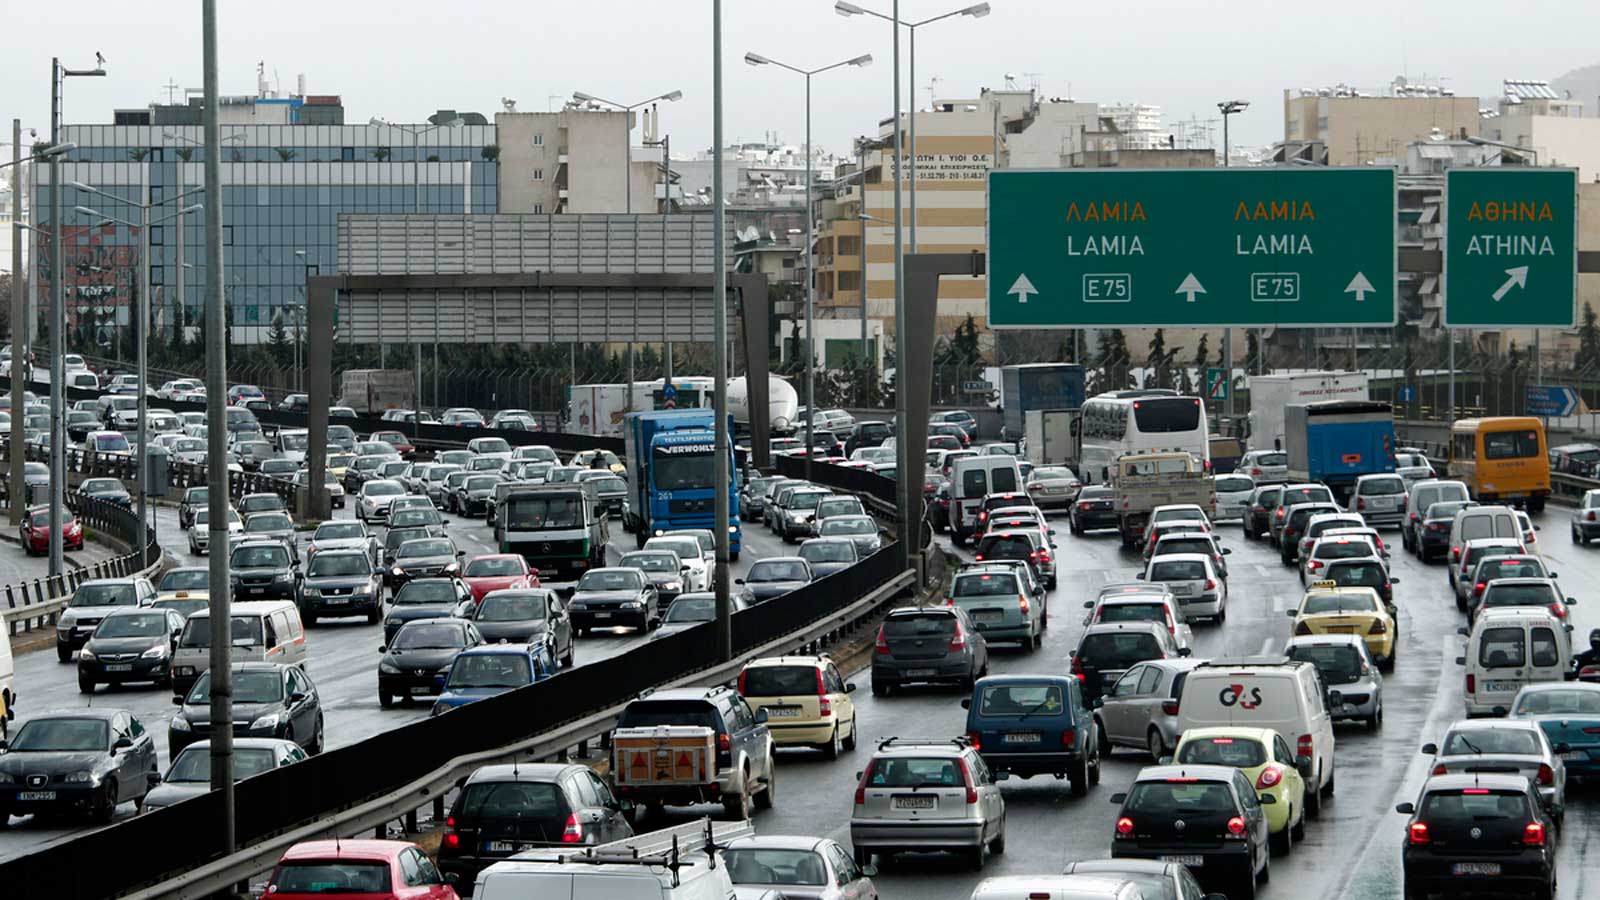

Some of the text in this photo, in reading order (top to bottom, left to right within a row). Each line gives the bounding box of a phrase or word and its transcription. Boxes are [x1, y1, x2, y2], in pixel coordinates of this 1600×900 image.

[1066, 201, 1147, 221] ΛΑΜΙΑ
[1234, 201, 1315, 221] ΛΑΜΙΑ
[1468, 201, 1553, 221] ΑΘΗΝΑ
[1067, 235, 1145, 255] LAMIA
[1236, 234, 1313, 254] LAMIA
[1466, 235, 1555, 255] ATHINA
[1219, 684, 1263, 709] G4S
